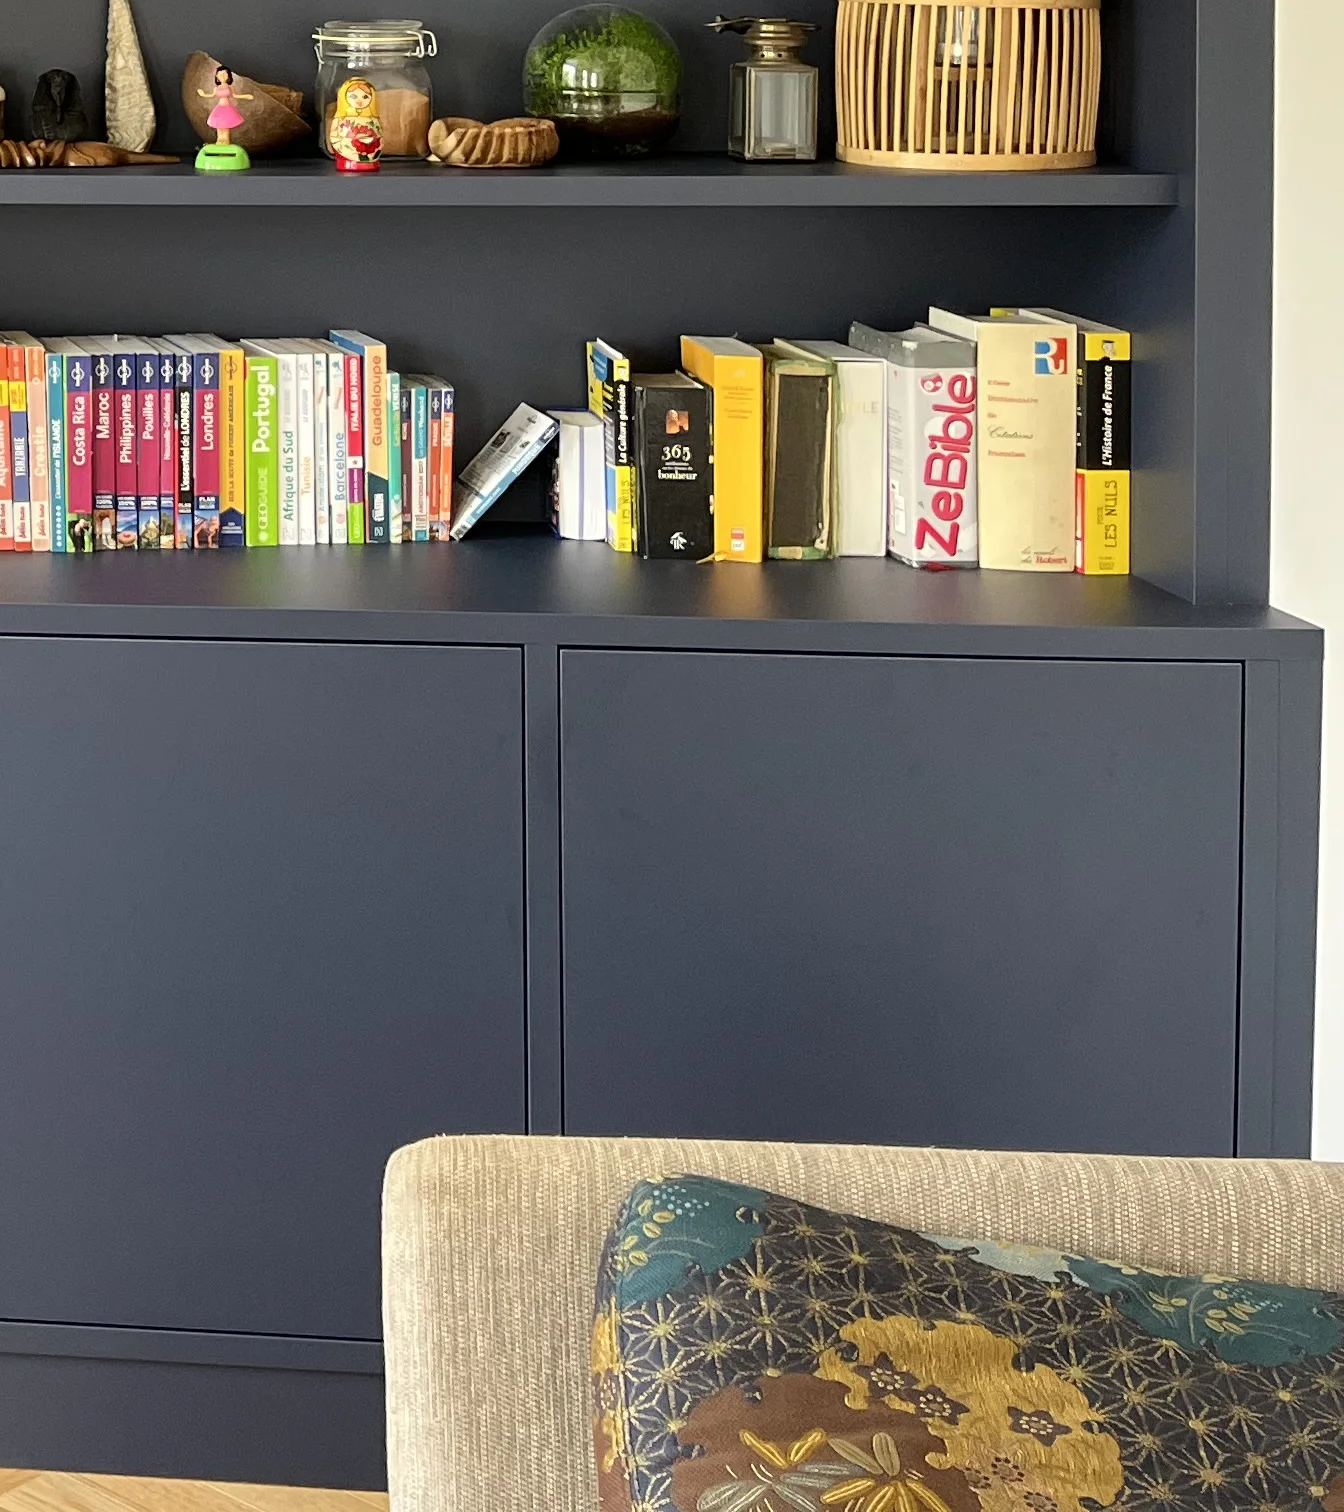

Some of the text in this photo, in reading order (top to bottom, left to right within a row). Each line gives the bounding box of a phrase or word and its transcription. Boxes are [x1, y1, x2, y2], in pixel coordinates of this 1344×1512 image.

[97, 392, 111, 439] Maroc
[120, 393, 136, 464] Philippines
[143, 393, 154, 440] Pouilles
[201, 393, 215, 451] Londres
[251, 365, 275, 454] Portugal
[350, 357, 360, 432] ITALIE DU NORD
[372, 355, 384, 447] Guadeloupe
[617, 384, 629, 464] La Culture générale
[1102, 365, 1113, 467] L'Histoire de France
[33, 425, 47, 477] Croatie
[72, 395, 86, 466] Costa Rica
[180, 391, 191, 491] L'essentiel de LONDRES
[661, 443, 691, 462] 365
[915, 372, 977, 557] ZeBible
[283, 431, 296, 522] Afrique du Sud
[301, 456, 311, 496] Tunisie
[333, 432, 345, 501] Barcelone
[657, 468, 698, 481] bonheur
[1104, 479, 1118, 549] LES NULS
